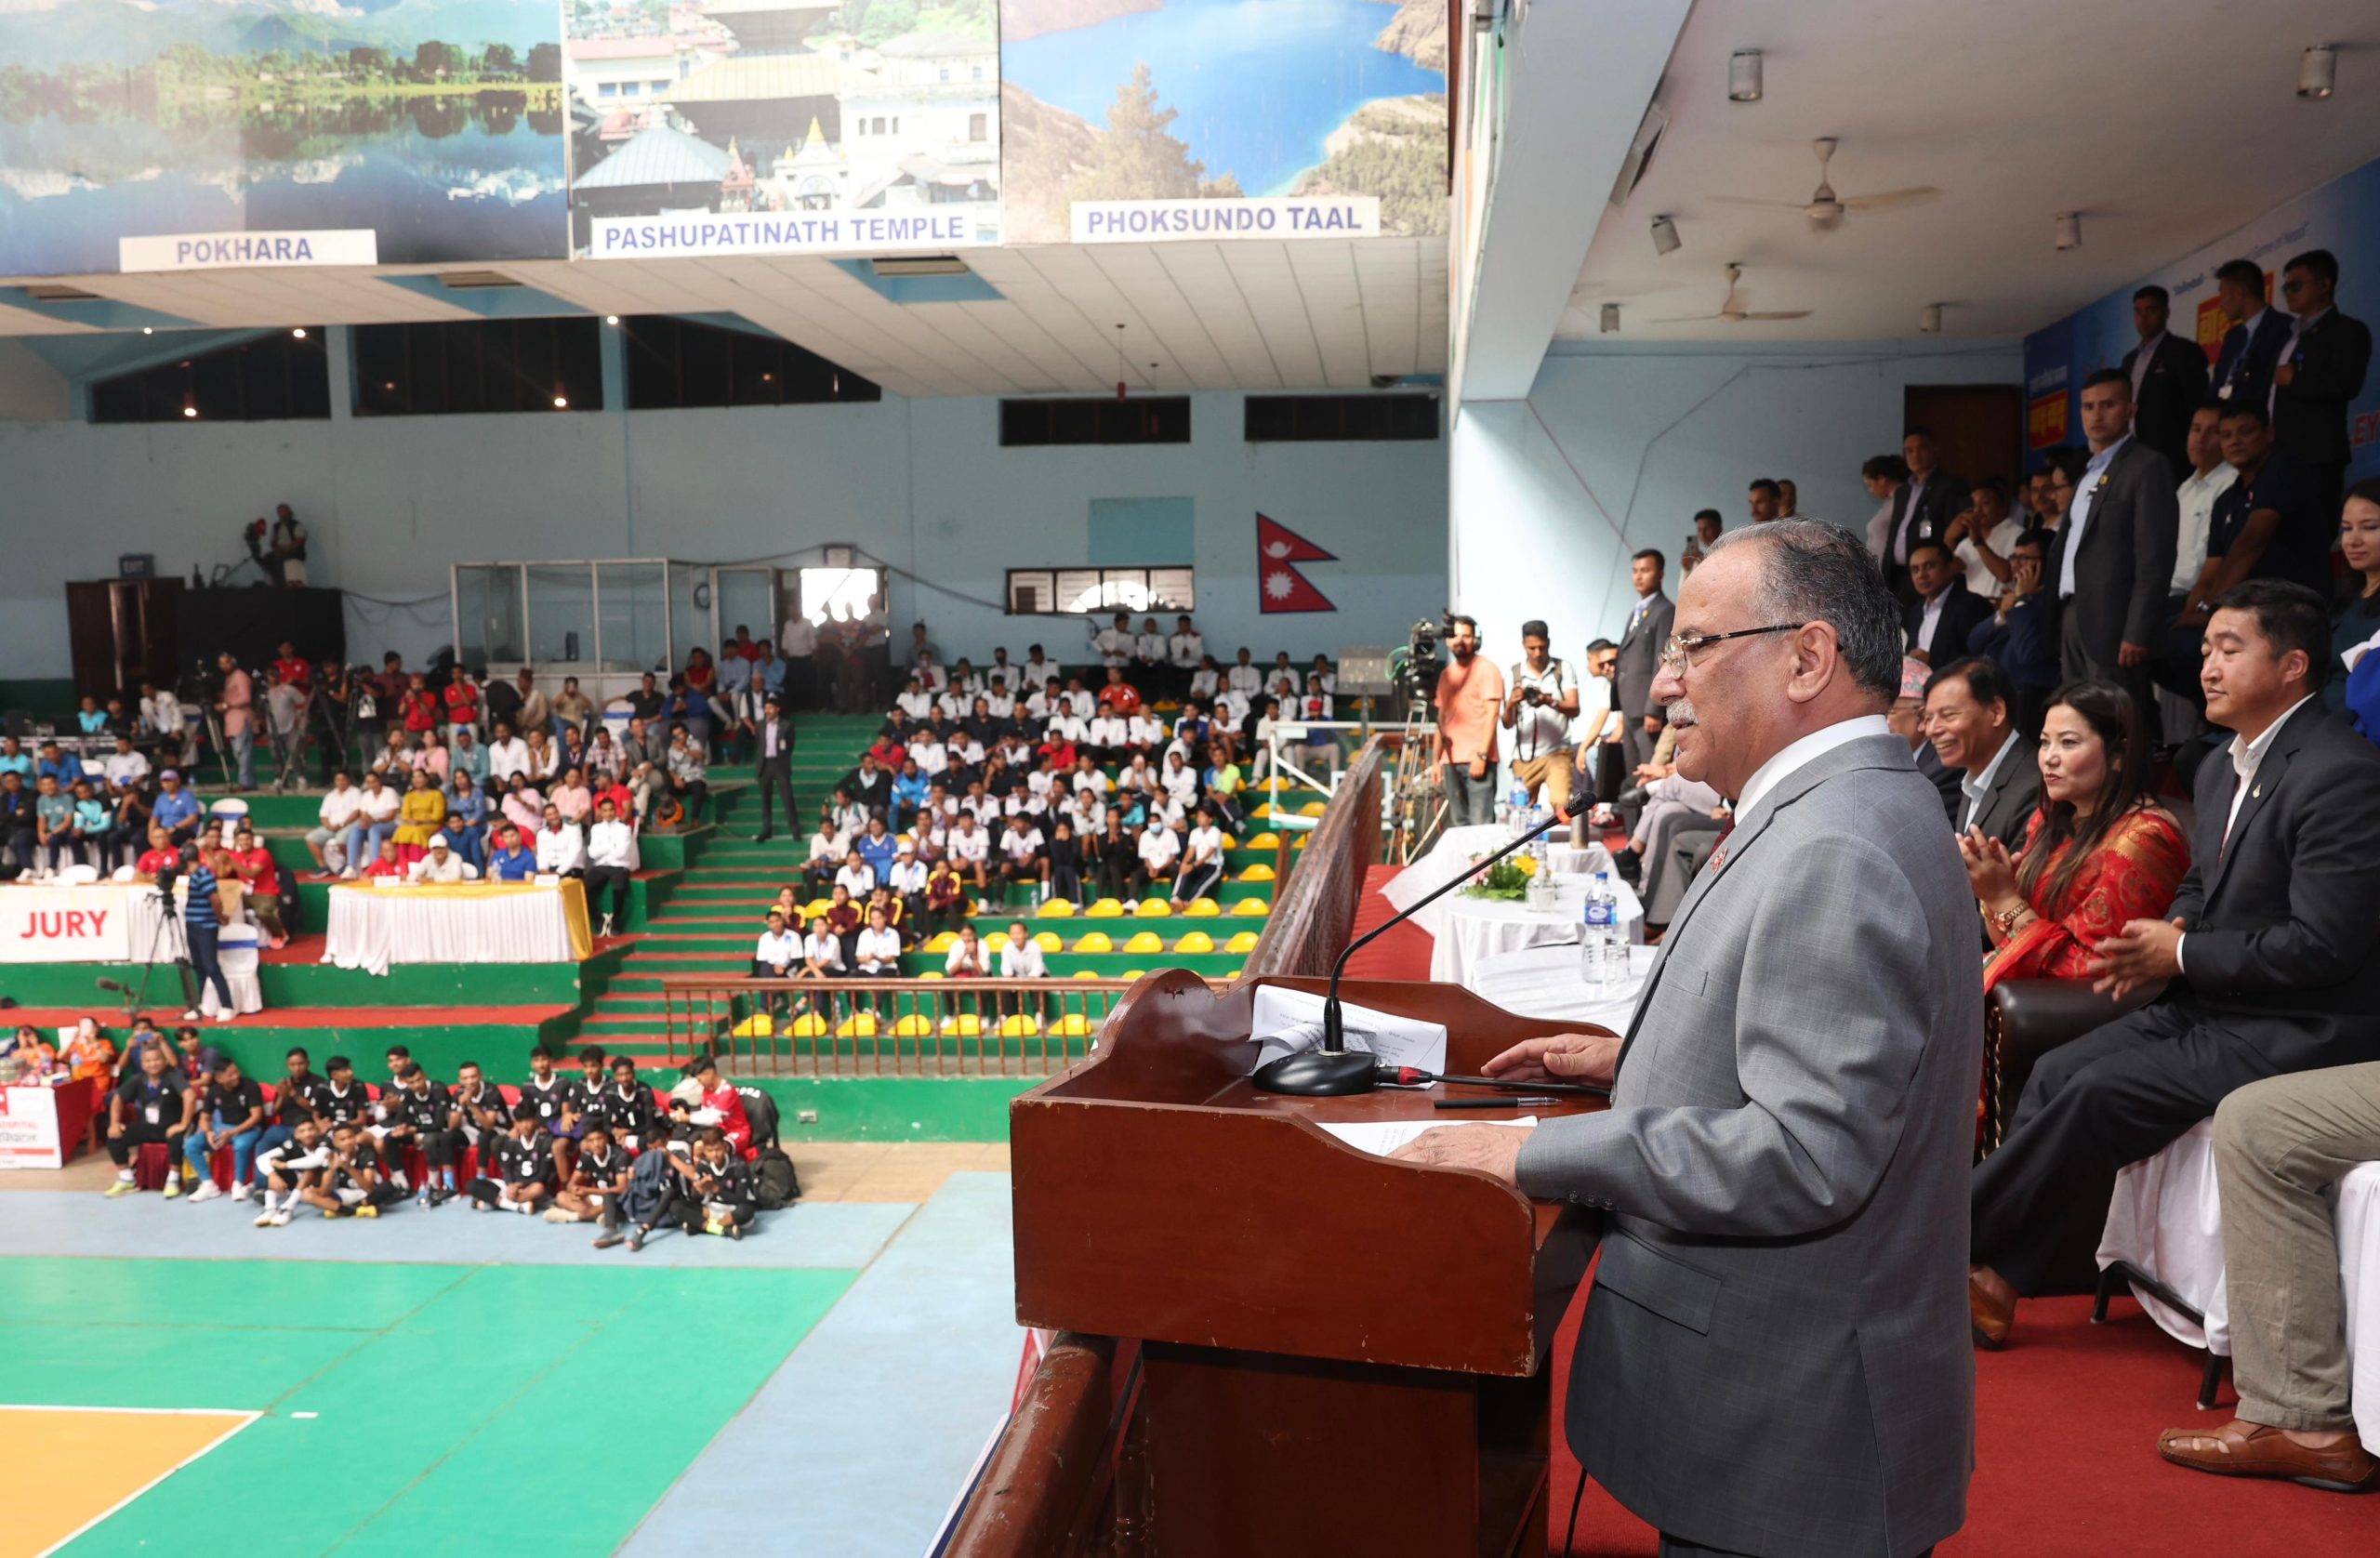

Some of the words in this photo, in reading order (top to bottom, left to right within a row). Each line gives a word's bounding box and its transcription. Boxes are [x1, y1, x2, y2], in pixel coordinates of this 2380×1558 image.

[605, 219, 839, 250] PASHUPATINATH
[850, 216, 963, 242] TEMPLE
[1088, 206, 1276, 233] PHOKSUNDO
[1288, 206, 1362, 230] TAAL
[177, 238, 313, 264] POKHARA
[20, 910, 108, 939] JURY
